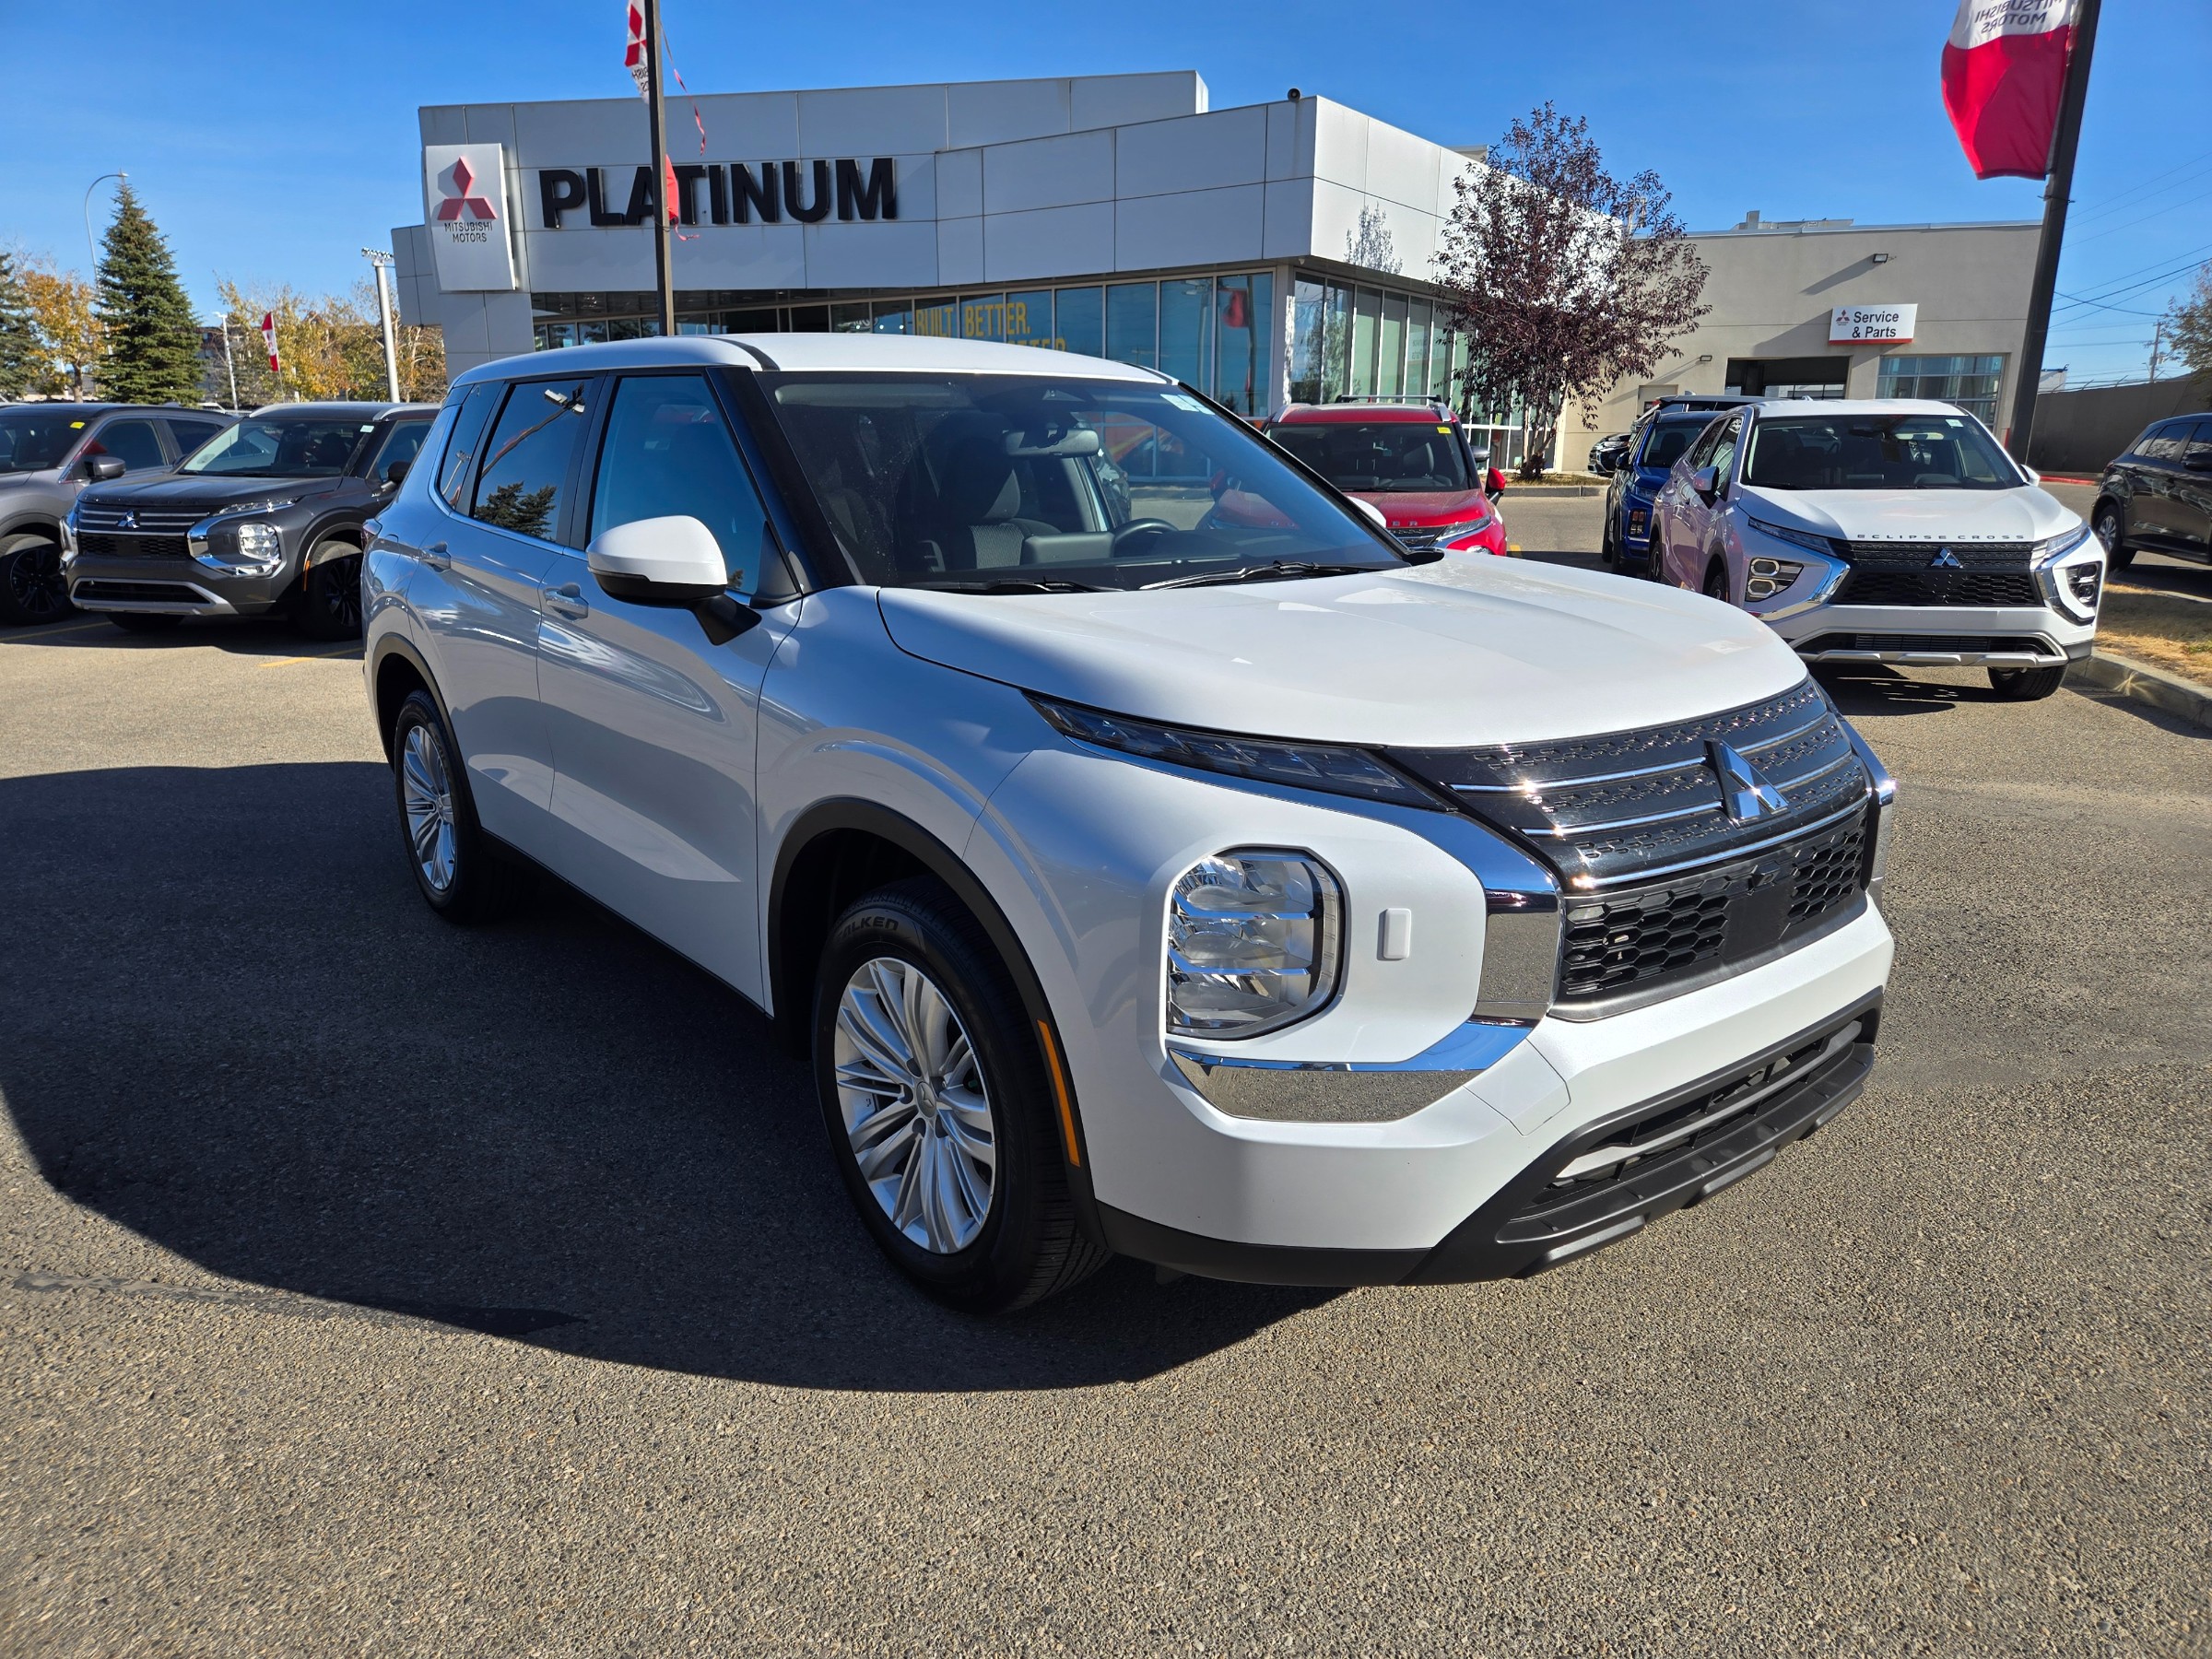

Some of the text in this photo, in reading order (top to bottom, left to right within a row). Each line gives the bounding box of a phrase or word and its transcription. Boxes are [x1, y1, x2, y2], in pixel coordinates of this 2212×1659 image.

[538, 158, 897, 228] PLATINUM
[444, 222, 493, 231] MITSUBISHI
[453, 232, 488, 242] MOTORS
[915, 307, 954, 337] BUILT
[964, 302, 1031, 337] BETTER.
[1853, 311, 1899, 324] Service
[1852, 326, 1897, 338] & Parts
